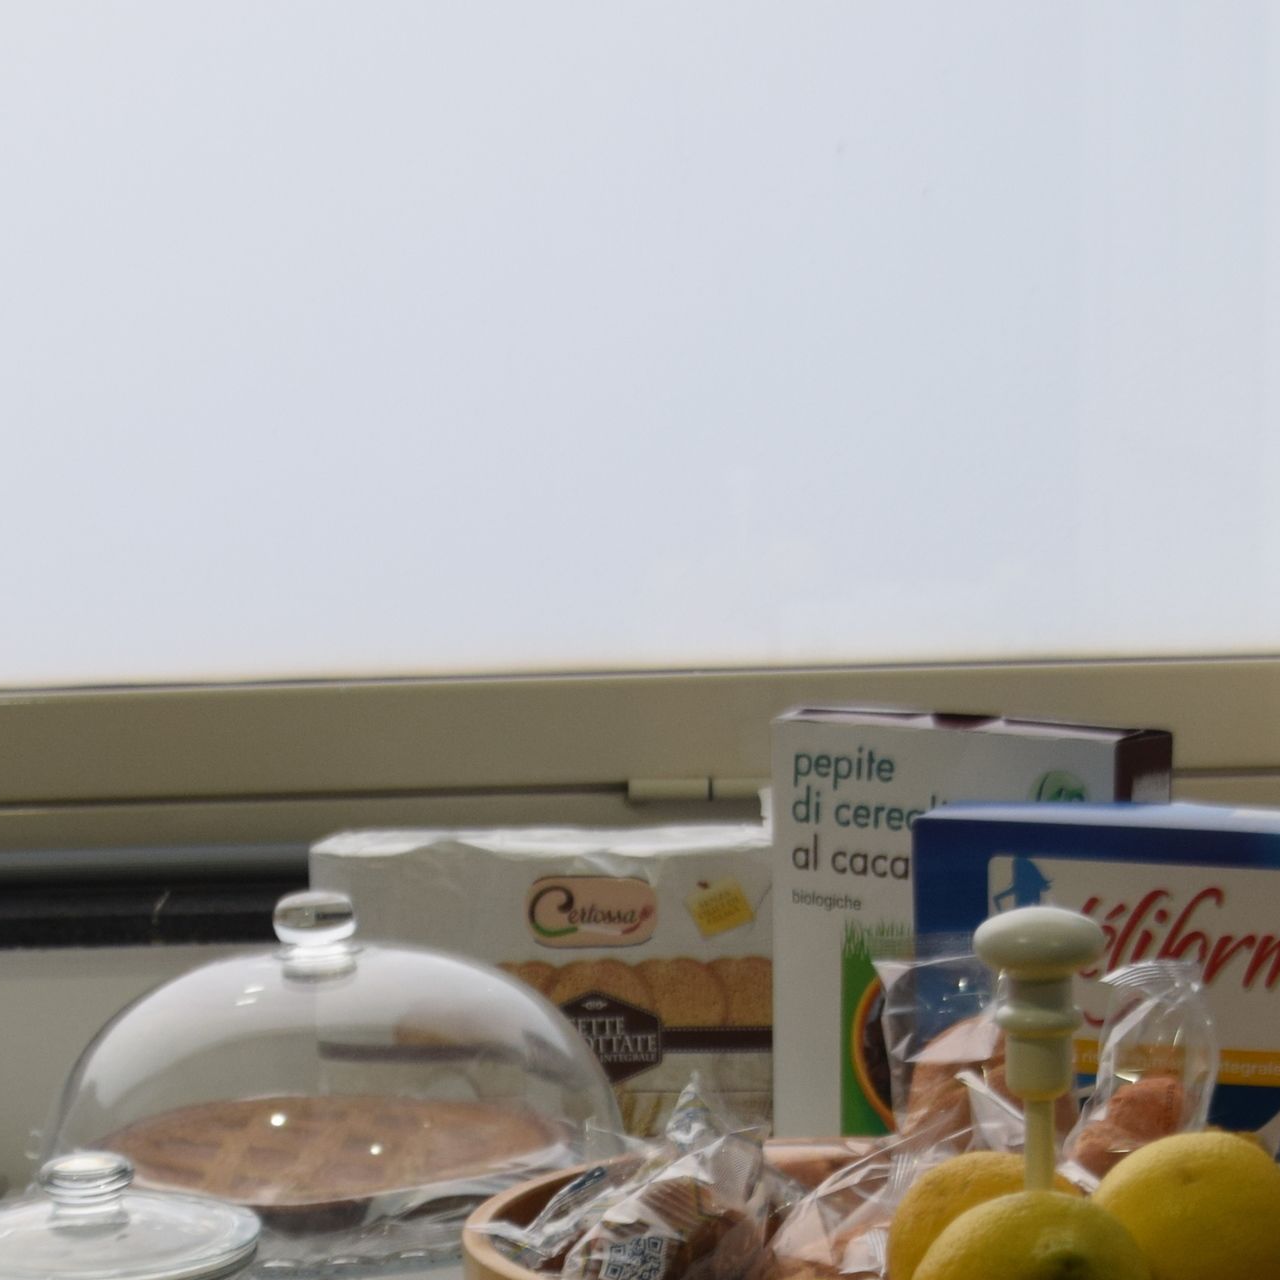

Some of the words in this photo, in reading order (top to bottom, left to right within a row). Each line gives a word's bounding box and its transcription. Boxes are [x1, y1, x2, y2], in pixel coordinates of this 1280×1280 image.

[793, 747, 894, 789] pepite
[792, 785, 822, 825] di
[834, 796, 944, 832] cerea
[792, 834, 818, 871] al
[831, 849, 910, 880] caca
[529, 886, 640, 938] Certossa
[791, 889, 862, 911] biologiche
